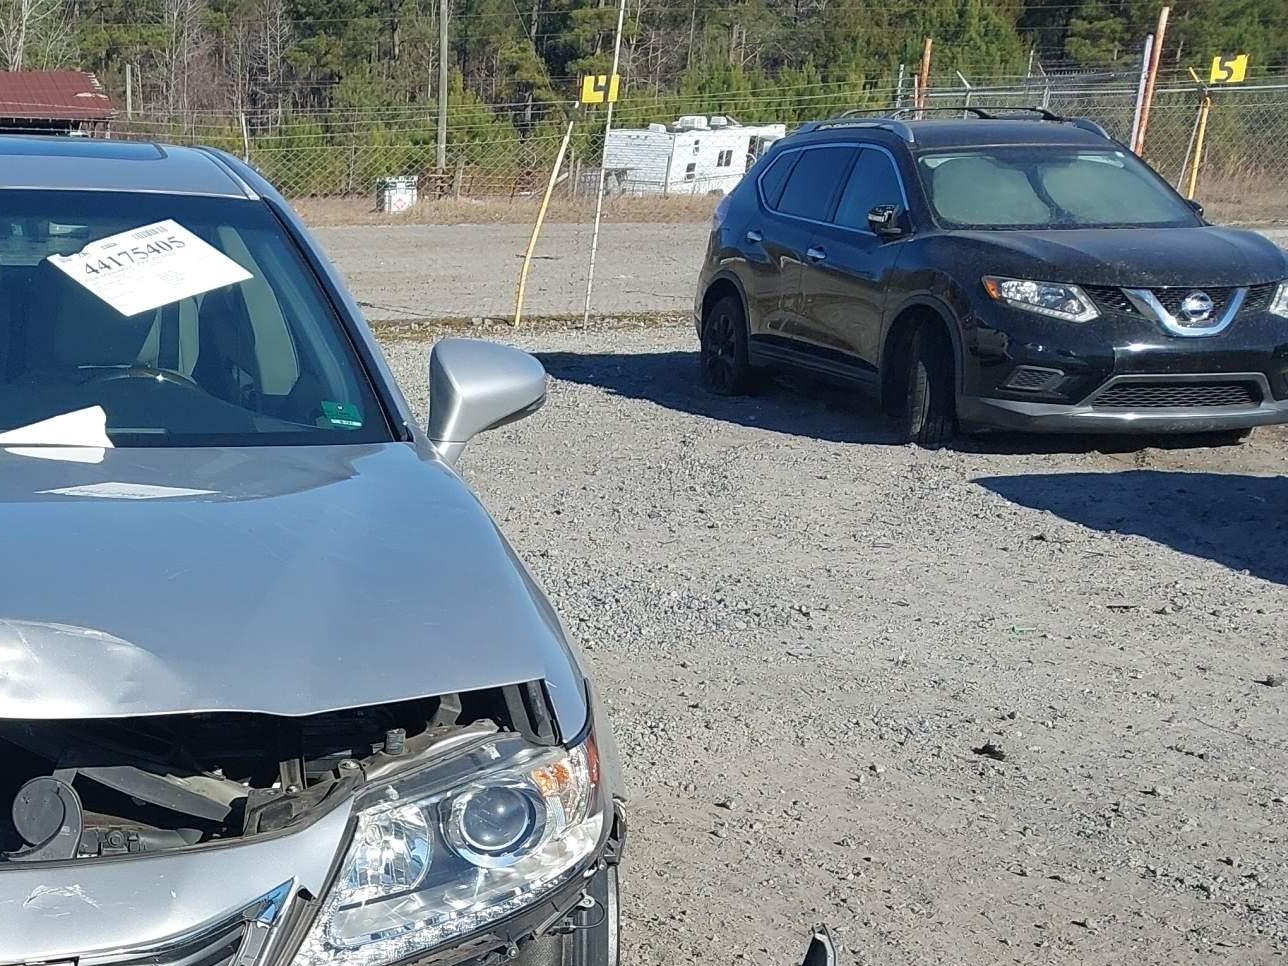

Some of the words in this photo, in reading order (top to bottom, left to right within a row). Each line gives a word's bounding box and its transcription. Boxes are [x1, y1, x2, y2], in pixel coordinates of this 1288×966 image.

[1214, 56, 1237, 82] 5
[593, 75, 612, 102] 4
[84, 236, 187, 275] 44175405
